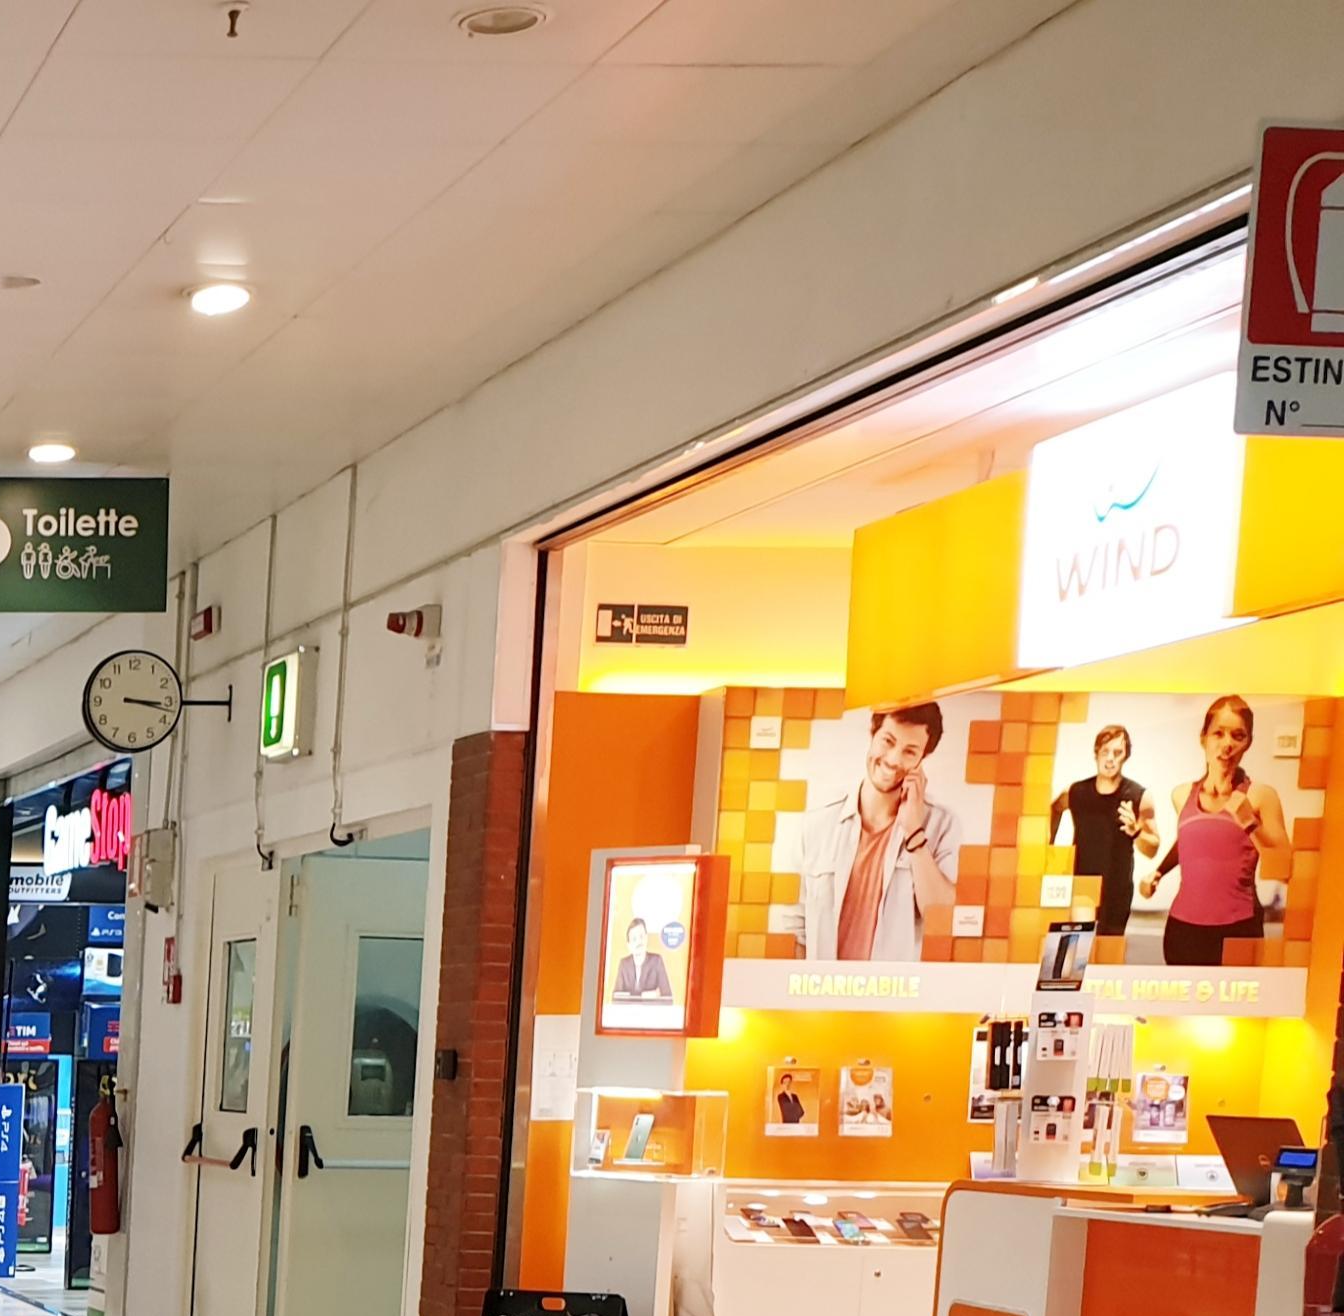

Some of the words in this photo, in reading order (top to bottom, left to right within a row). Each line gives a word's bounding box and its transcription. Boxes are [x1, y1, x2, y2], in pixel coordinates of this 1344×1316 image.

[1264, 399, 1301, 427] N°
[21, 506, 140, 538] Toilette
[1056, 523, 1180, 603] WIND
[639, 613, 671, 625] USCITA
[672, 615, 683, 625] DI
[634, 624, 686, 636] EMERGENZA
[112, 663, 122, 675] 11
[128, 658, 142, 671] 12
[150, 664, 156, 675] 1
[98, 677, 112, 690] 10
[159, 677, 169, 690] 2
[93, 695, 103, 708] 9
[163, 695, 173, 708] 3
[98, 713, 108, 726] 8
[158, 713, 167, 726] 4
[111, 726, 120, 739] 7
[127, 731, 137, 744] 6
[145, 726, 155, 739] 5
[10, 873, 65, 887] mobile
[787, 973, 921, 998] RICARICABILE
[1131, 978, 1193, 1001] HOME
[1195, 980, 1215, 1002] &
[1218, 980, 1261, 1002] LIFE
[15, 1025, 37, 1037] TIM
[0, 1121, 11, 1153] PS4
